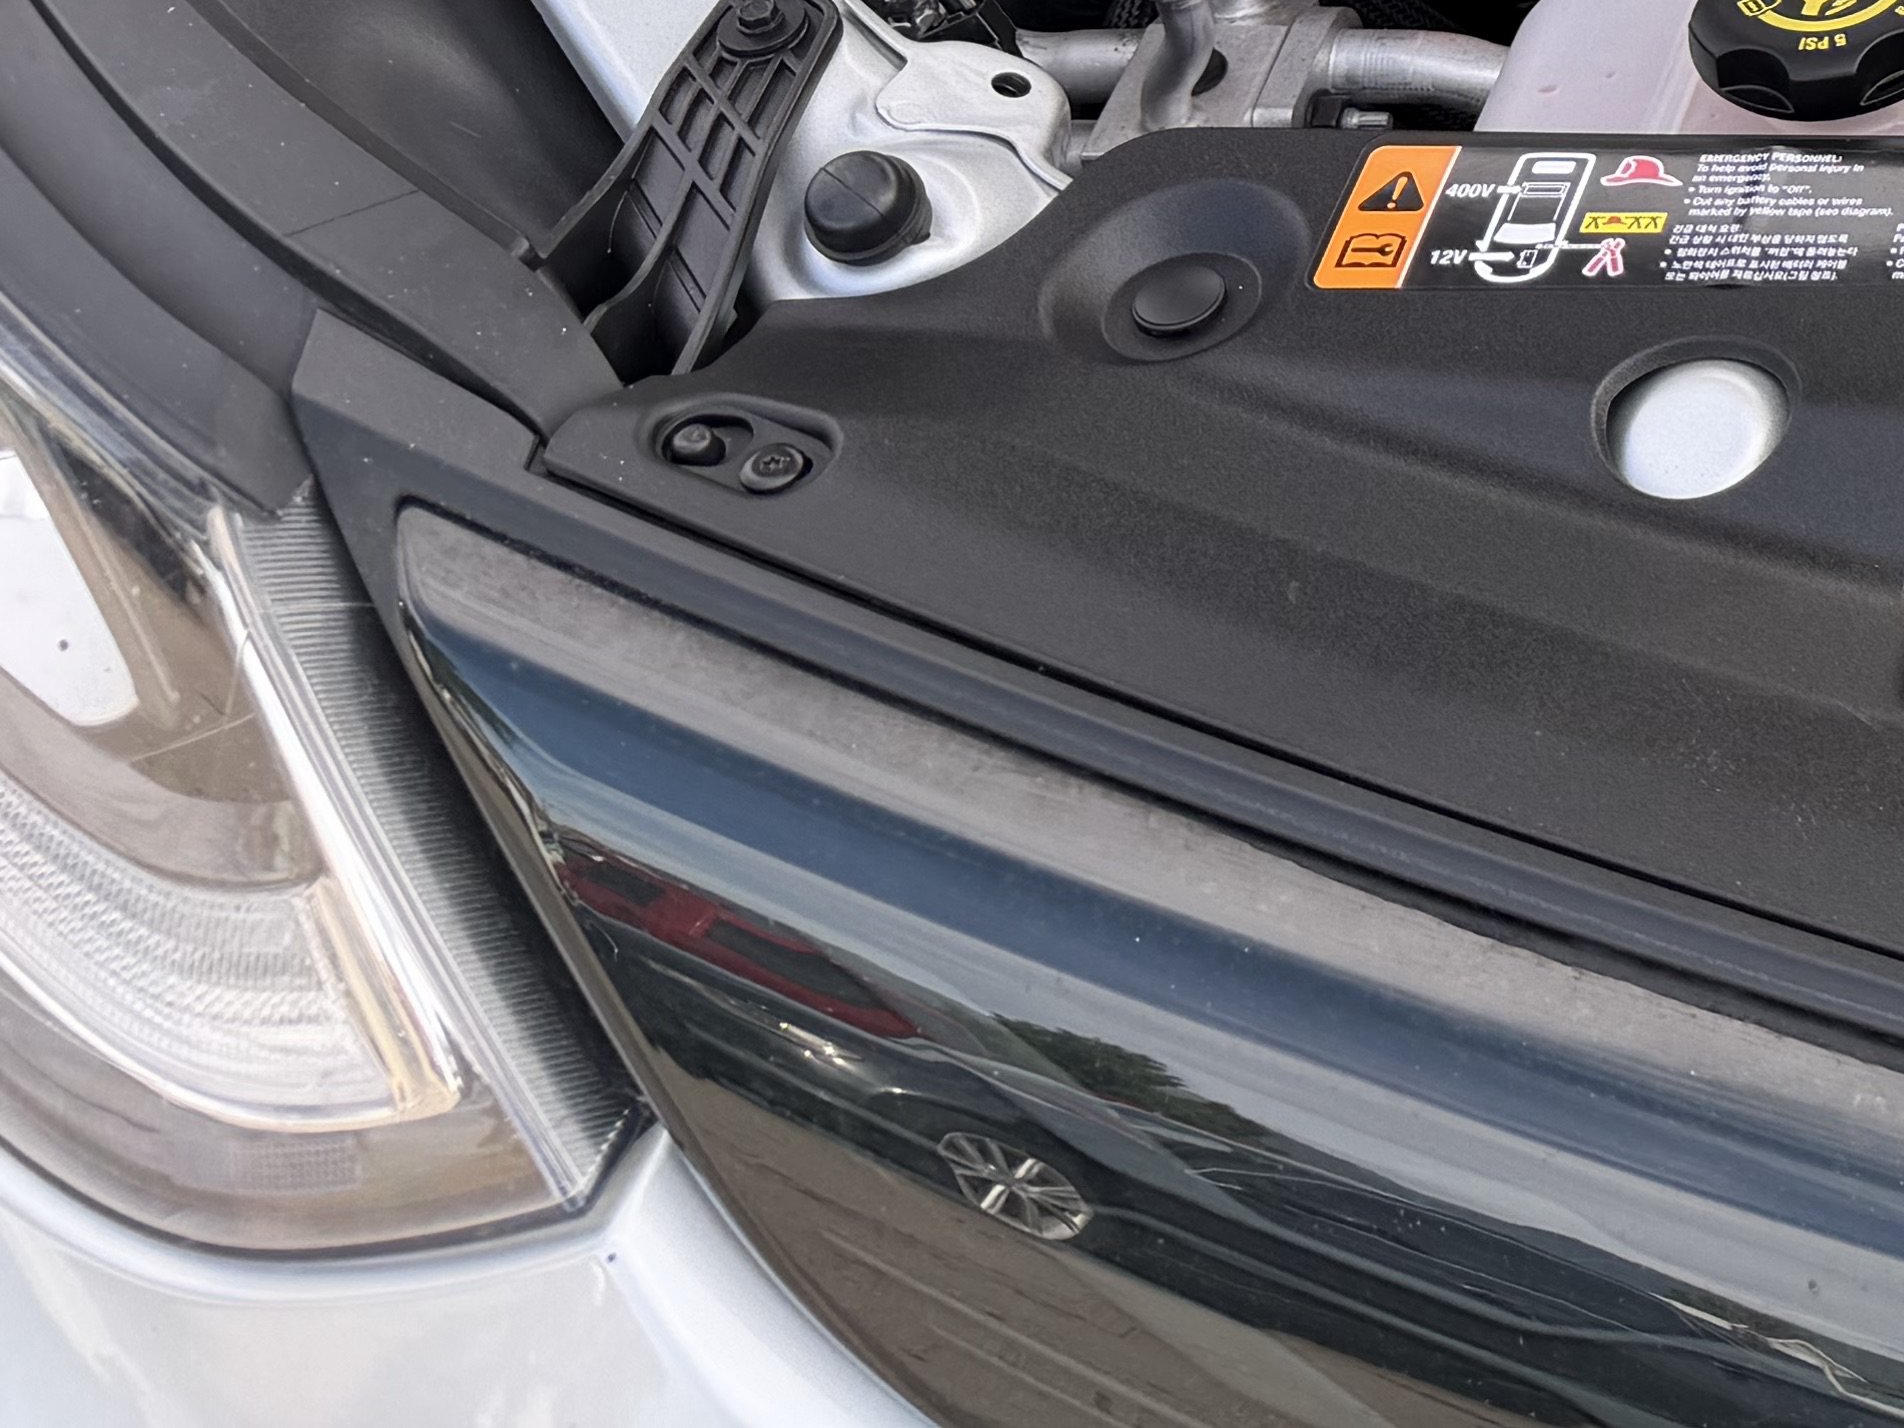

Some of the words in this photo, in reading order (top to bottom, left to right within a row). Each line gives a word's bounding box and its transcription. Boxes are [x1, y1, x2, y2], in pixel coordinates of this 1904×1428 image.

[1798, 35, 1830, 51] PSI
[1834, 33, 1848, 47] 5
[1699, 153, 1769, 163] EMERGENCY
[1771, 153, 1842, 162] PERSONNEL:
[1697, 164, 1707, 173] To
[1711, 164, 1733, 173] help
[1736, 164, 1767, 173] avoid
[1769, 164, 1815, 173] personal
[1819, 164, 1852, 173] injury
[1707, 173, 1771, 183] emergency.
[1445, 183, 1496, 197] 400V
[1698, 185, 1721, 194] Turn
[1724, 185, 1765, 194] ignition
[1693, 197, 1712, 207] Cut
[1715, 197, 1734, 207] any
[1737, 197, 1776, 207] battery
[1778, 197, 1814, 206] cables
[1831, 196, 1862, 206] wires
[1688, 207, 1731, 217] marked
[1734, 207, 1747, 217] by
[1749, 207, 1784, 217] yellow
[1788, 207, 1812, 217] tape
[1815, 207, 1838, 217] (see
[1843, 207, 1894, 217] diagram).
[1430, 249, 1467, 265] 12V
